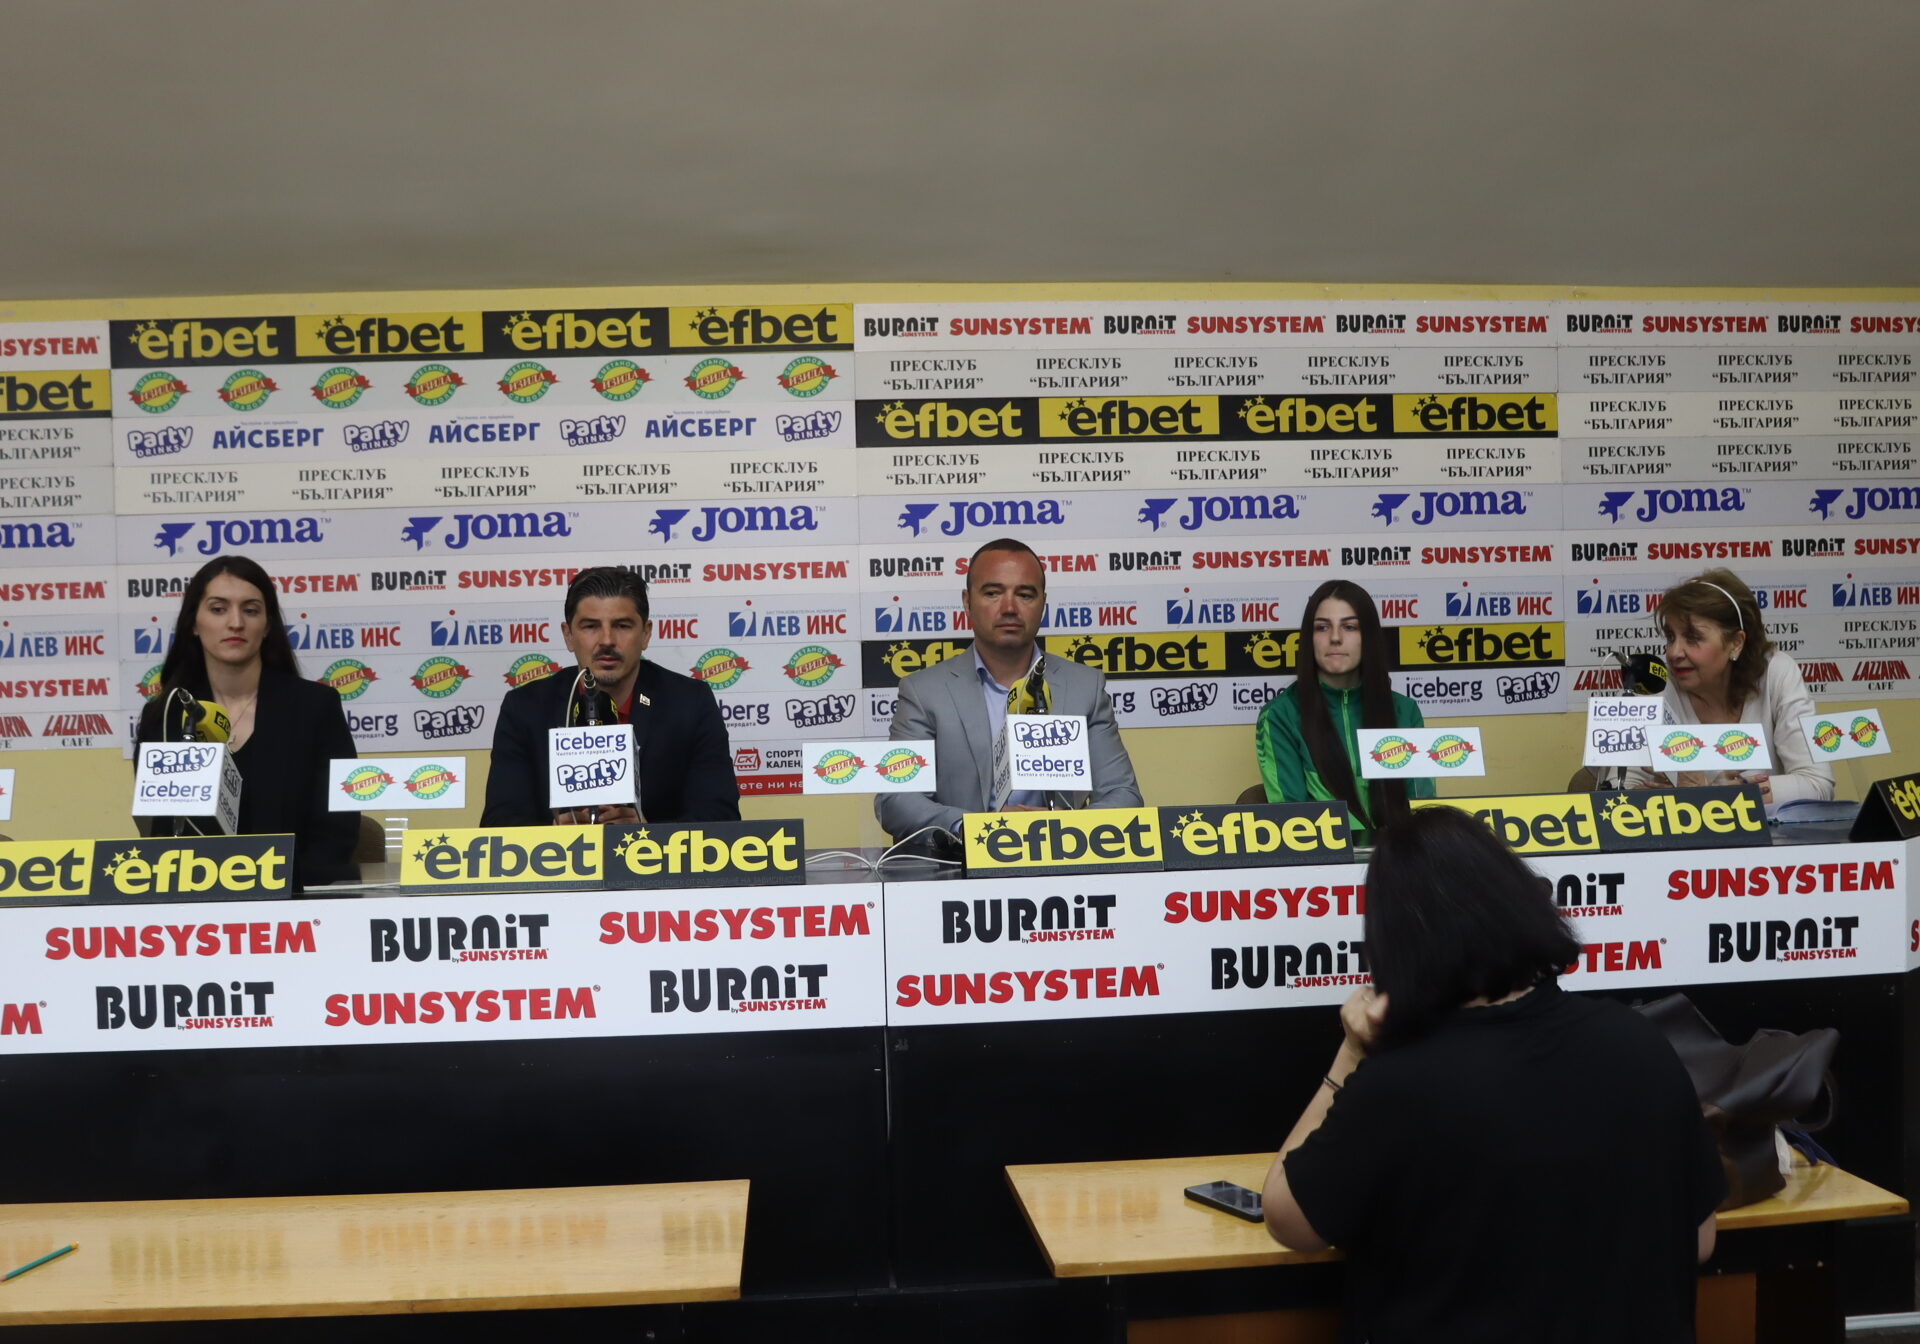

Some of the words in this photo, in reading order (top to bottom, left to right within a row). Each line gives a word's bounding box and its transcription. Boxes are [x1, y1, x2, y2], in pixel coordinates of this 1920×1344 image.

[512, 311, 651, 351] efbet
[698, 308, 838, 345] efbet
[1187, 316, 1326, 333] SUNSYSTEM
[1416, 316, 1549, 333] SUNSYSTEM
[138, 320, 278, 359] efbet
[325, 318, 464, 354] efbet
[891, 360, 976, 371] ПРЕСКЛУБ
[1839, 355, 1911, 365] ПРЕСКЛУБ
[508, 372, 545, 392] ИЗИДА
[696, 368, 732, 389] ИЗИДА
[789, 367, 824, 386] ИЗИДА
[1246, 397, 1377, 433] efbet
[1420, 396, 1546, 430] efbet
[1720, 400, 1793, 410] ПРЕСКЛУБ
[646, 415, 756, 438] АЙСБЕРГ
[776, 411, 841, 435] Party
[885, 401, 1022, 439] efbet
[1068, 399, 1202, 435] efbet
[213, 426, 324, 449] АЙСБЕРГ
[344, 420, 409, 444] Party
[429, 420, 540, 443] АЙСБЕРГ
[785, 429, 829, 442] DRINKS
[352, 439, 397, 452] DRINKS
[1311, 449, 1392, 460] ПРЕСКЛУБ
[1718, 444, 1791, 455] ПРЕСКЛУБ
[894, 454, 979, 466] ПРЕСКЛУБ
[1178, 451, 1260, 462] ПРЕСКЛУБ
[151, 472, 237, 484] ПРЕСКЛУБ
[584, 464, 670, 476] ПРЕСКЛУБ
[1193, 549, 1331, 569] SUNSYSTEM
[1422, 545, 1553, 564] SUNSYSTEM
[1648, 541, 1773, 560] SUNSYSTEM
[703, 560, 849, 582] SUNSYSTEM
[1606, 594, 1640, 613] ЛЕВ
[1774, 589, 1807, 608] ИНС
[1860, 587, 1892, 606] ЛЕВ
[908, 612, 946, 631] ЛЕВ
[1055, 607, 1092, 627] ЛЕВ
[1099, 606, 1137, 626] ИНС
[1199, 604, 1235, 623] ЛЕВ
[1242, 603, 1279, 622] ИНС
[464, 625, 503, 645] ЛЕВ
[510, 623, 549, 643] ИНС
[762, 616, 800, 636] ЛЕВ
[807, 614, 846, 635] ИНС
[1844, 620, 1916, 632] ПРЕСКЛУБ
[20, 637, 58, 657] ЛЕВ
[65, 635, 104, 656] ИНС
[1074, 635, 1207, 672] efbet
[1426, 625, 1552, 662] efbet
[422, 667, 459, 687] ИЗИДА
[701, 659, 737, 679] ИЗИДА
[794, 657, 830, 676] ИЗИДА
[1852, 660, 1910, 681] LAZZARIN
[1151, 683, 1217, 708] Party
[1406, 676, 1483, 700] iceberg
[1497, 672, 1559, 702] Party
[1505, 689, 1548, 704] DRINKS
[414, 705, 484, 732] Party
[786, 695, 855, 721] Party
[1160, 701, 1205, 716] DRINKS
[1594, 701, 1657, 720] iceberg
[42, 714, 113, 736] LAZZARIN
[795, 713, 842, 728] DRINKS
[1014, 720, 1080, 741] Party
[424, 725, 471, 739] DRINKS
[556, 732, 626, 751] iceberg
[1024, 736, 1069, 749] DRINKS
[147, 747, 216, 768] Party
[1600, 742, 1641, 753] DRINKS
[154, 763, 200, 775] DRINKS
[557, 758, 626, 785] Party
[1016, 755, 1084, 776] iceberg
[140, 781, 212, 801] iceberg
[567, 777, 614, 792] DRINKS
[737, 782, 763, 790] ете
[1611, 792, 1762, 836] efbet
[985, 816, 1154, 862] efbet
[1181, 808, 1347, 856] efbet
[424, 833, 596, 878] efbet
[625, 827, 797, 874] efbet
[113, 847, 285, 895] efbet
[1667, 861, 1895, 899] SUNSYSTEM
[599, 904, 870, 944] SUNSYSTEM
[45, 921, 316, 960] SUNSYSTEM
[896, 966, 1159, 1007] SUNSYSTEM
[325, 986, 596, 1026] SUNSYSTEM
